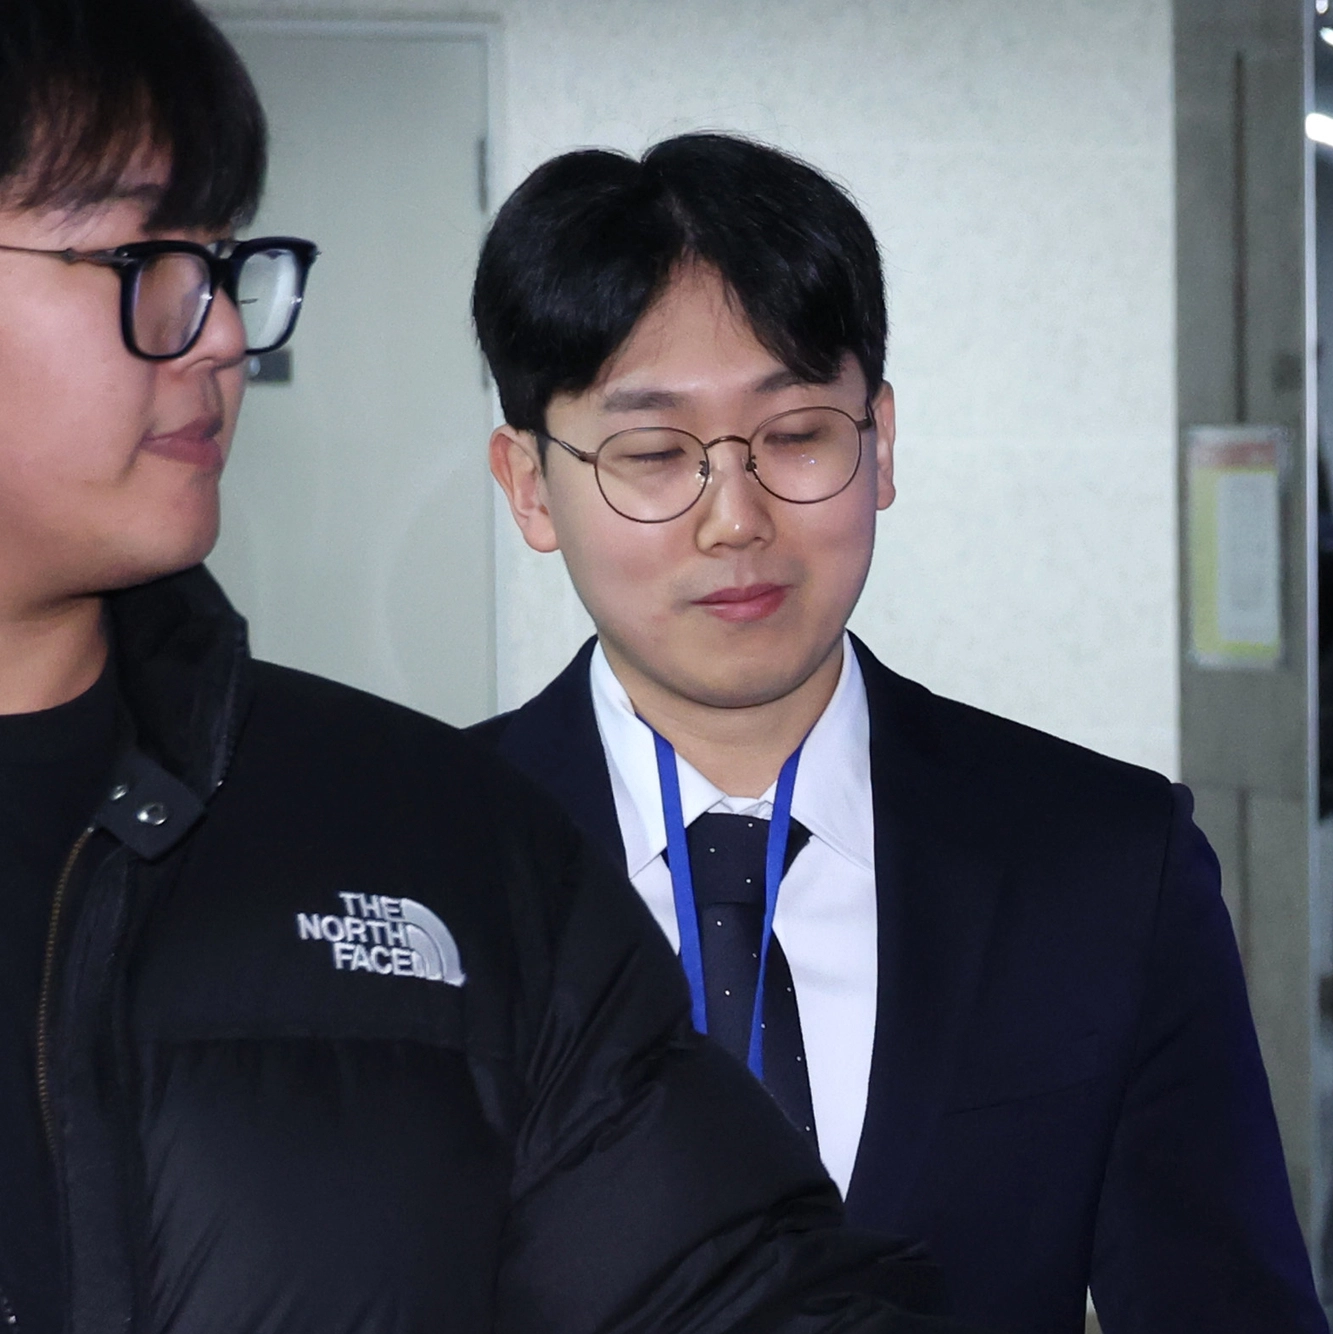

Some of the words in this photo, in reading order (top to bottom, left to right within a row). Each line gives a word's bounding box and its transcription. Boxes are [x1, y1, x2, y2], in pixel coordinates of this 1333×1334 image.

[338, 890, 401, 922] THE
[297, 913, 408, 948] NORTH
[333, 942, 416, 977] FACE
